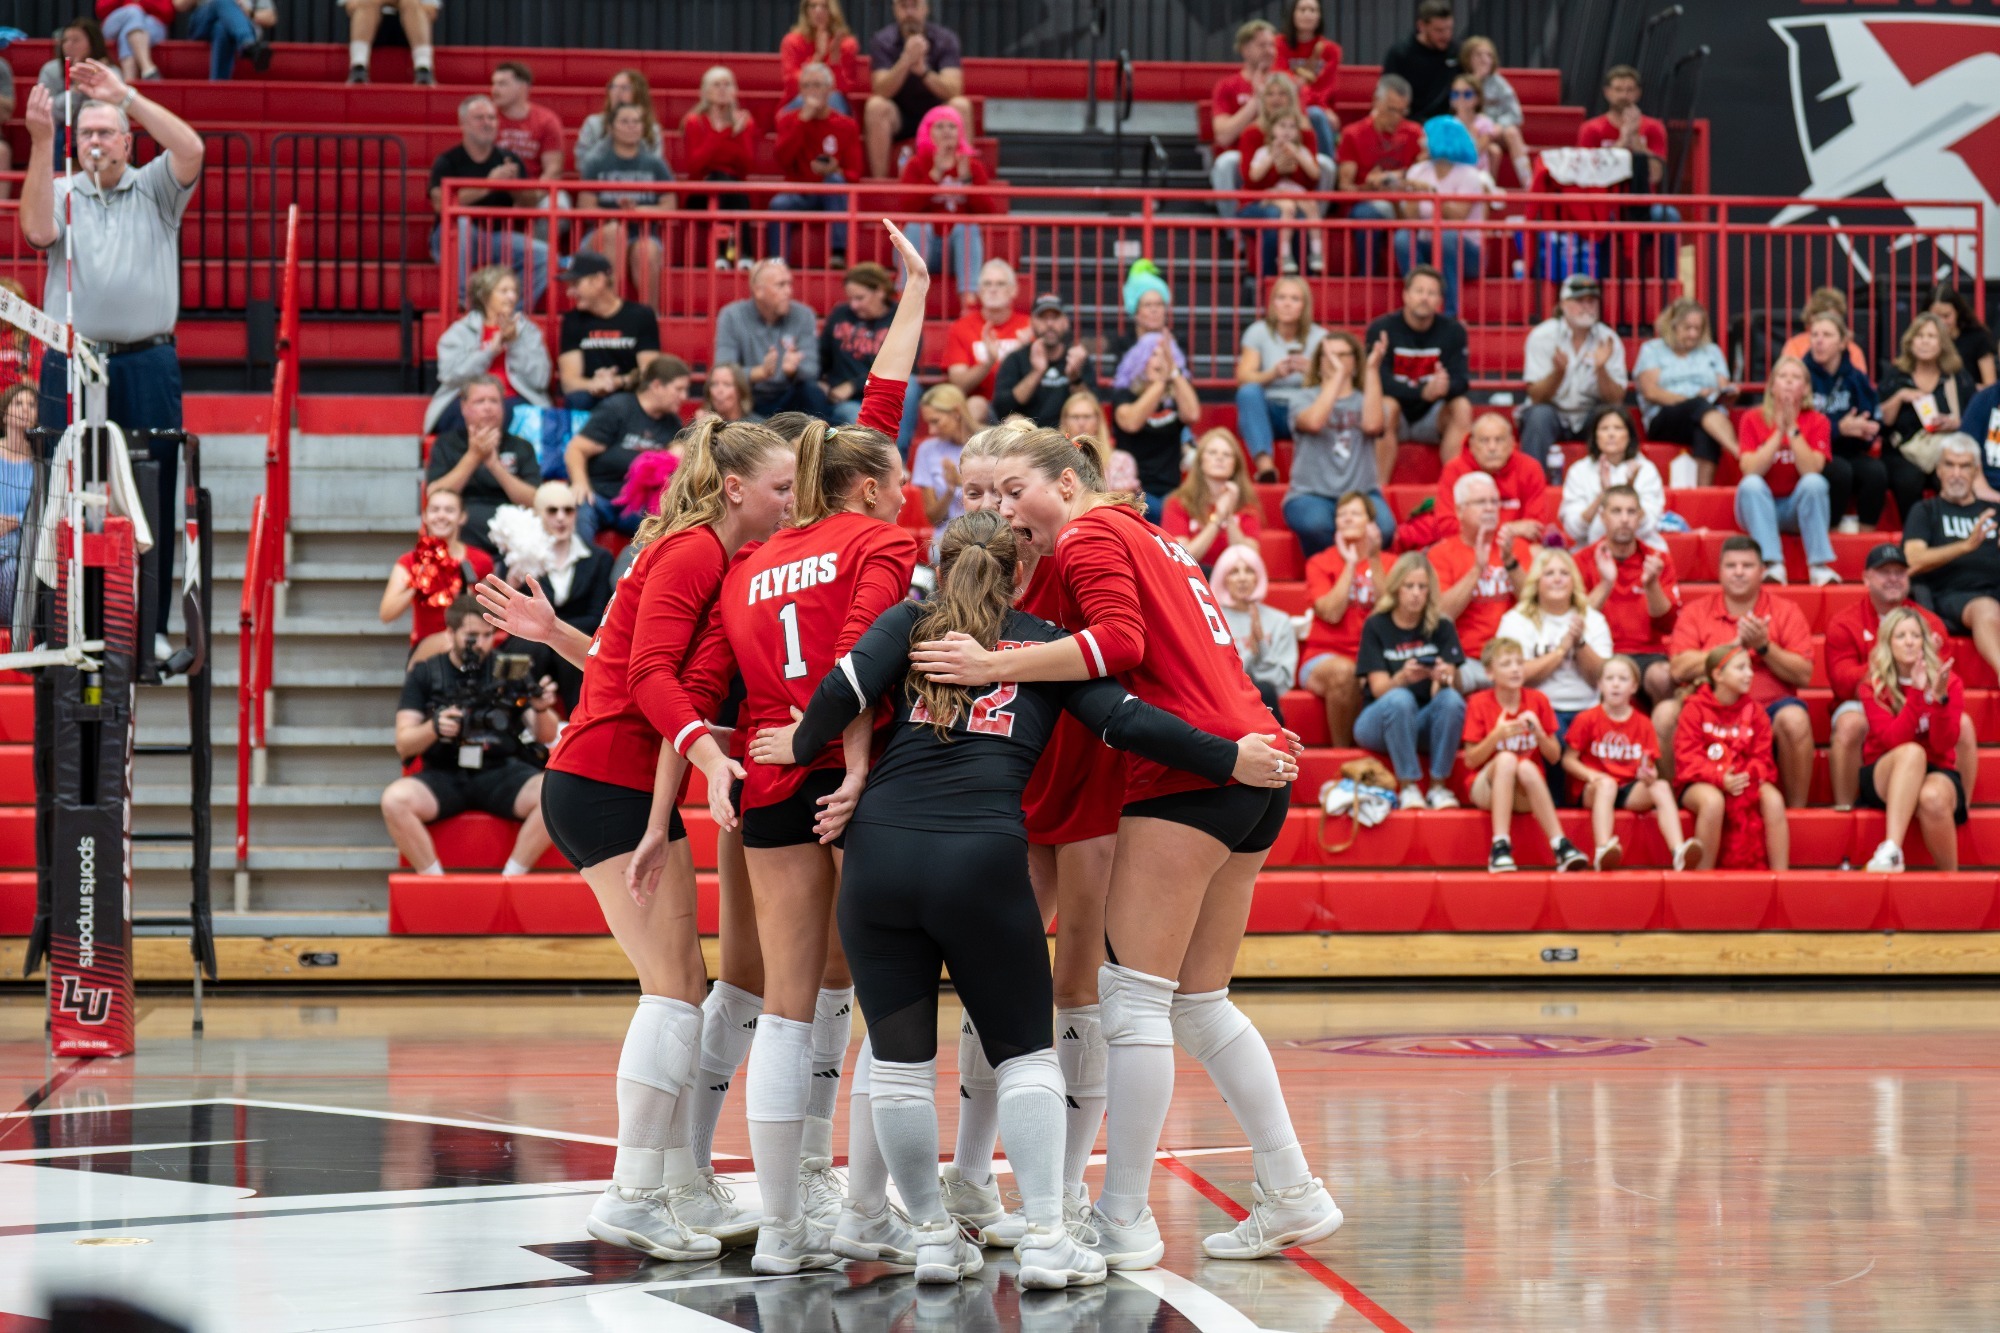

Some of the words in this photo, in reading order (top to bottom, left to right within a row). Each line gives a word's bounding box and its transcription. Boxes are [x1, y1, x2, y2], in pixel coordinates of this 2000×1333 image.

[748, 552, 838, 606] FLYERS
[778, 601, 808, 680] 1
[1187, 576, 1233, 646] 6
[1590, 740, 1642, 760] LEWIS
[77, 836, 97, 895] sports
[76, 896, 95, 968] imports
[60, 975, 112, 1026] LU
